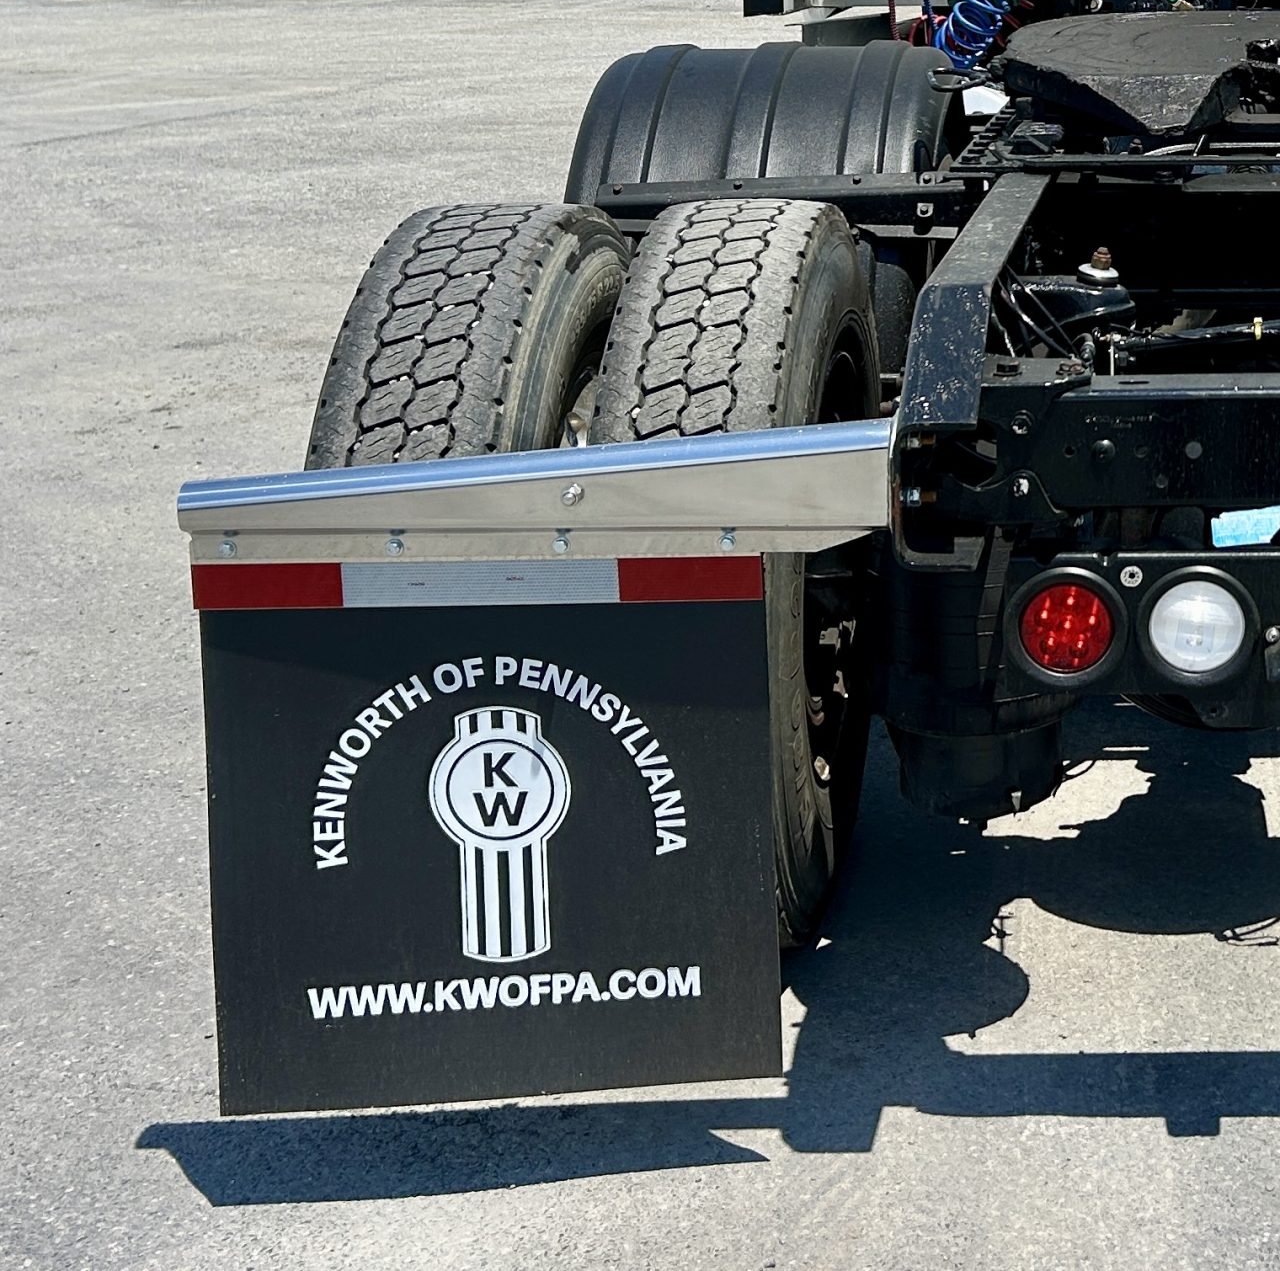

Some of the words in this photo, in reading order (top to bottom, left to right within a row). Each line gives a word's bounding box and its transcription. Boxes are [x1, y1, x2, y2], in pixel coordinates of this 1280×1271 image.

[313, 674, 433, 870] KENWORTH
[433, 656, 486, 694] OF
[495, 656, 688, 856] PENNSYLVANIA
[306, 965, 702, 1019] WWW.KWOFPA.COM
